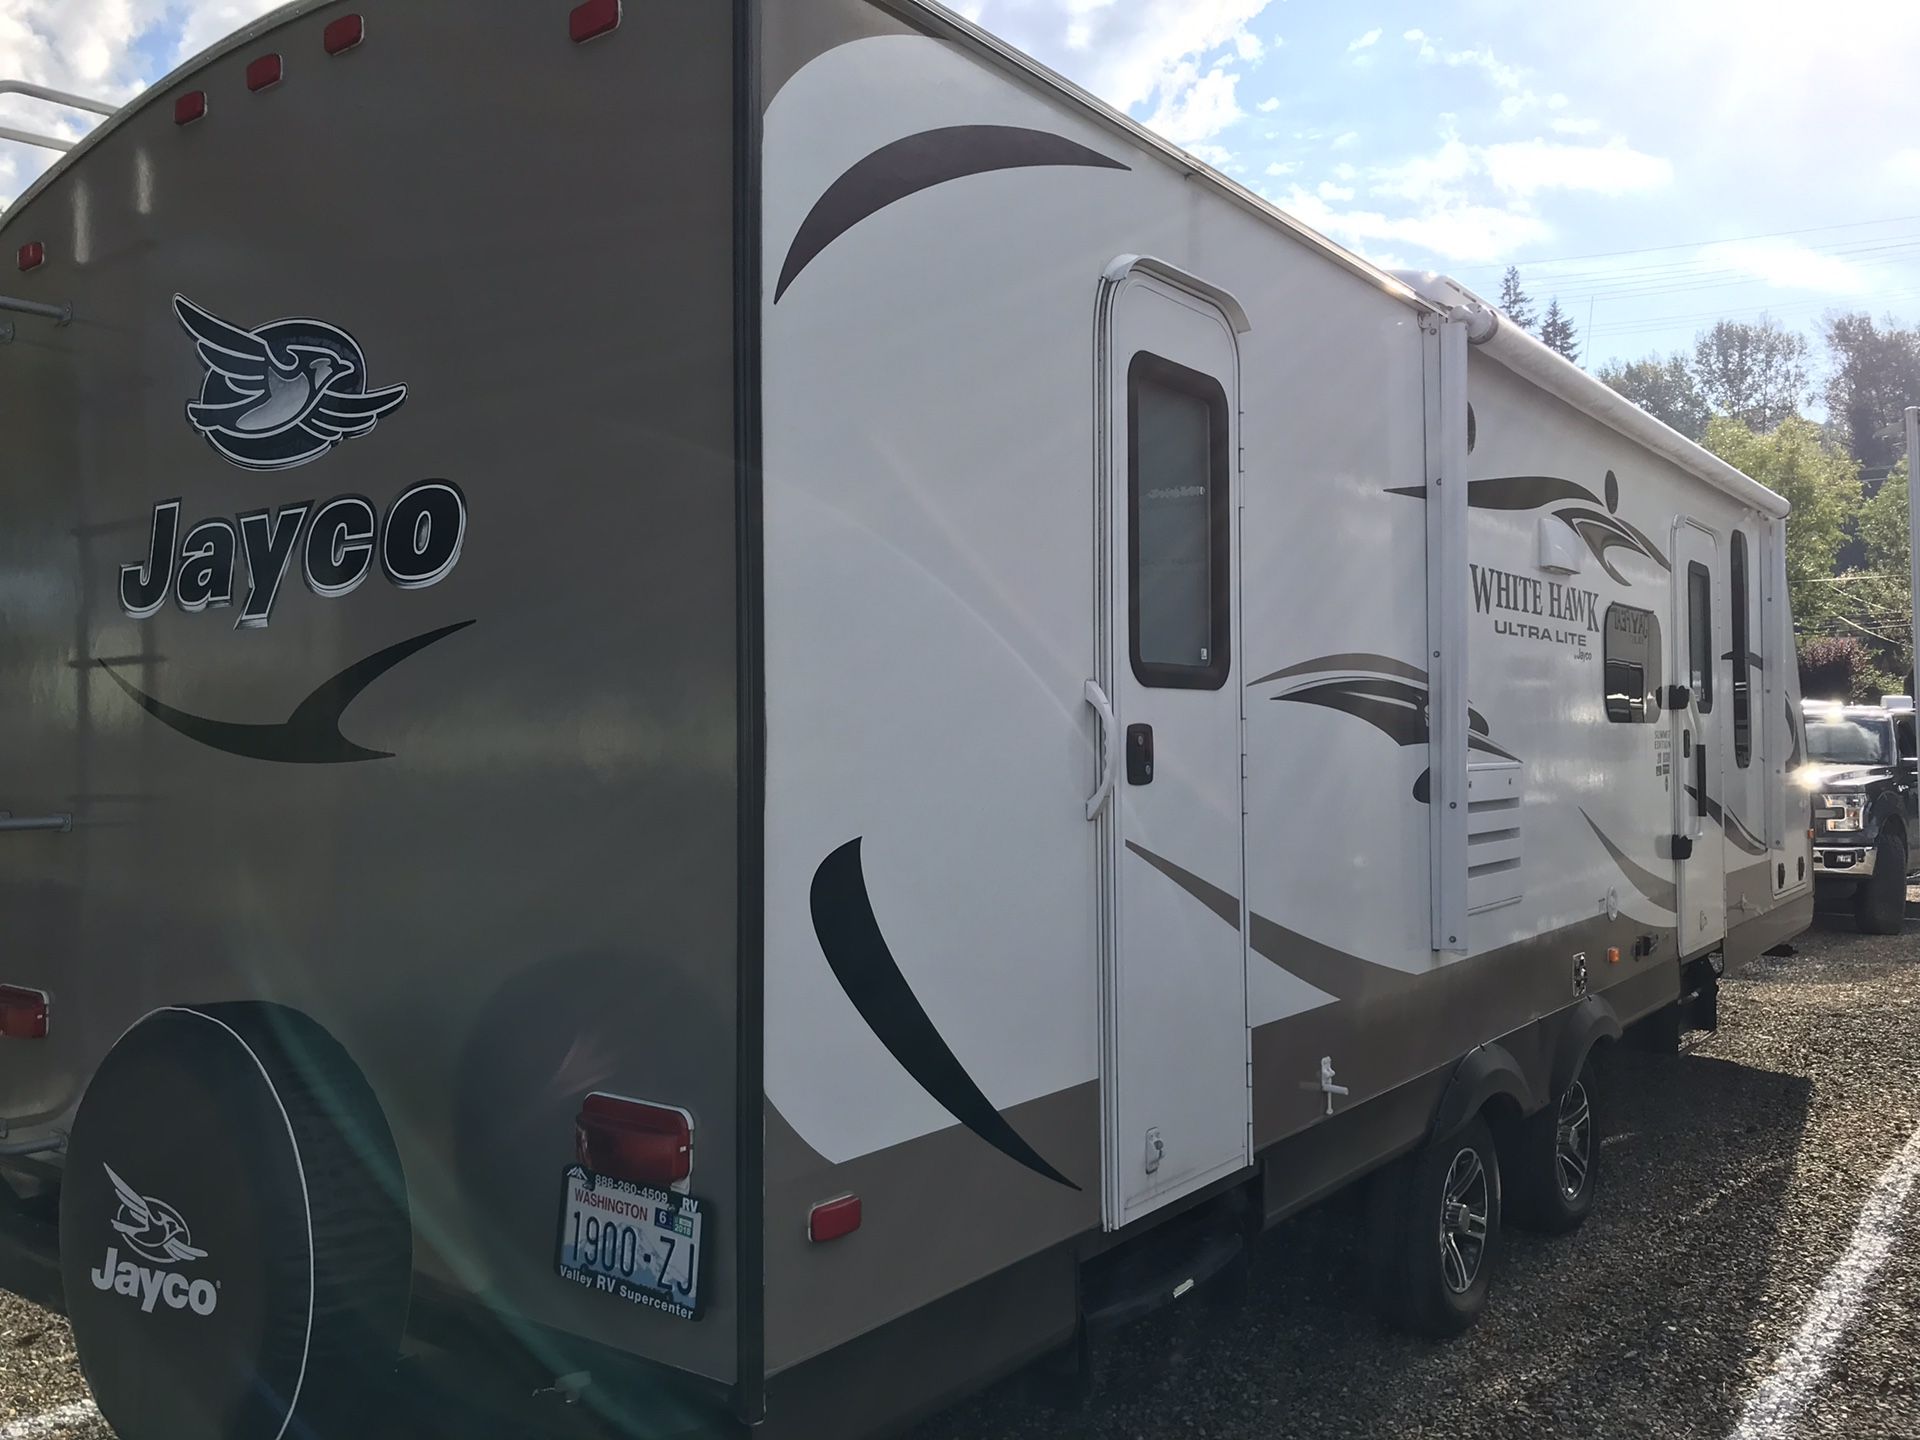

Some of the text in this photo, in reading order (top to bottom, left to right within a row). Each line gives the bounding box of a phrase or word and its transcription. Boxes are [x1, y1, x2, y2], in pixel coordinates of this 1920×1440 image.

[119, 478, 469, 630] Jayco
[1469, 563, 1600, 633] WHITE HAWK
[1494, 619, 1587, 647] ULTRA LITE
[575, 1187, 648, 1221] WASHINGTON
[595, 1174, 669, 1204] 888-260-4509
[682, 1197, 699, 1212] RV
[658, 1210, 668, 1225] 6
[91, 1247, 217, 1316] Jayco
[560, 1264, 693, 1320] Valley RV Supercenter
